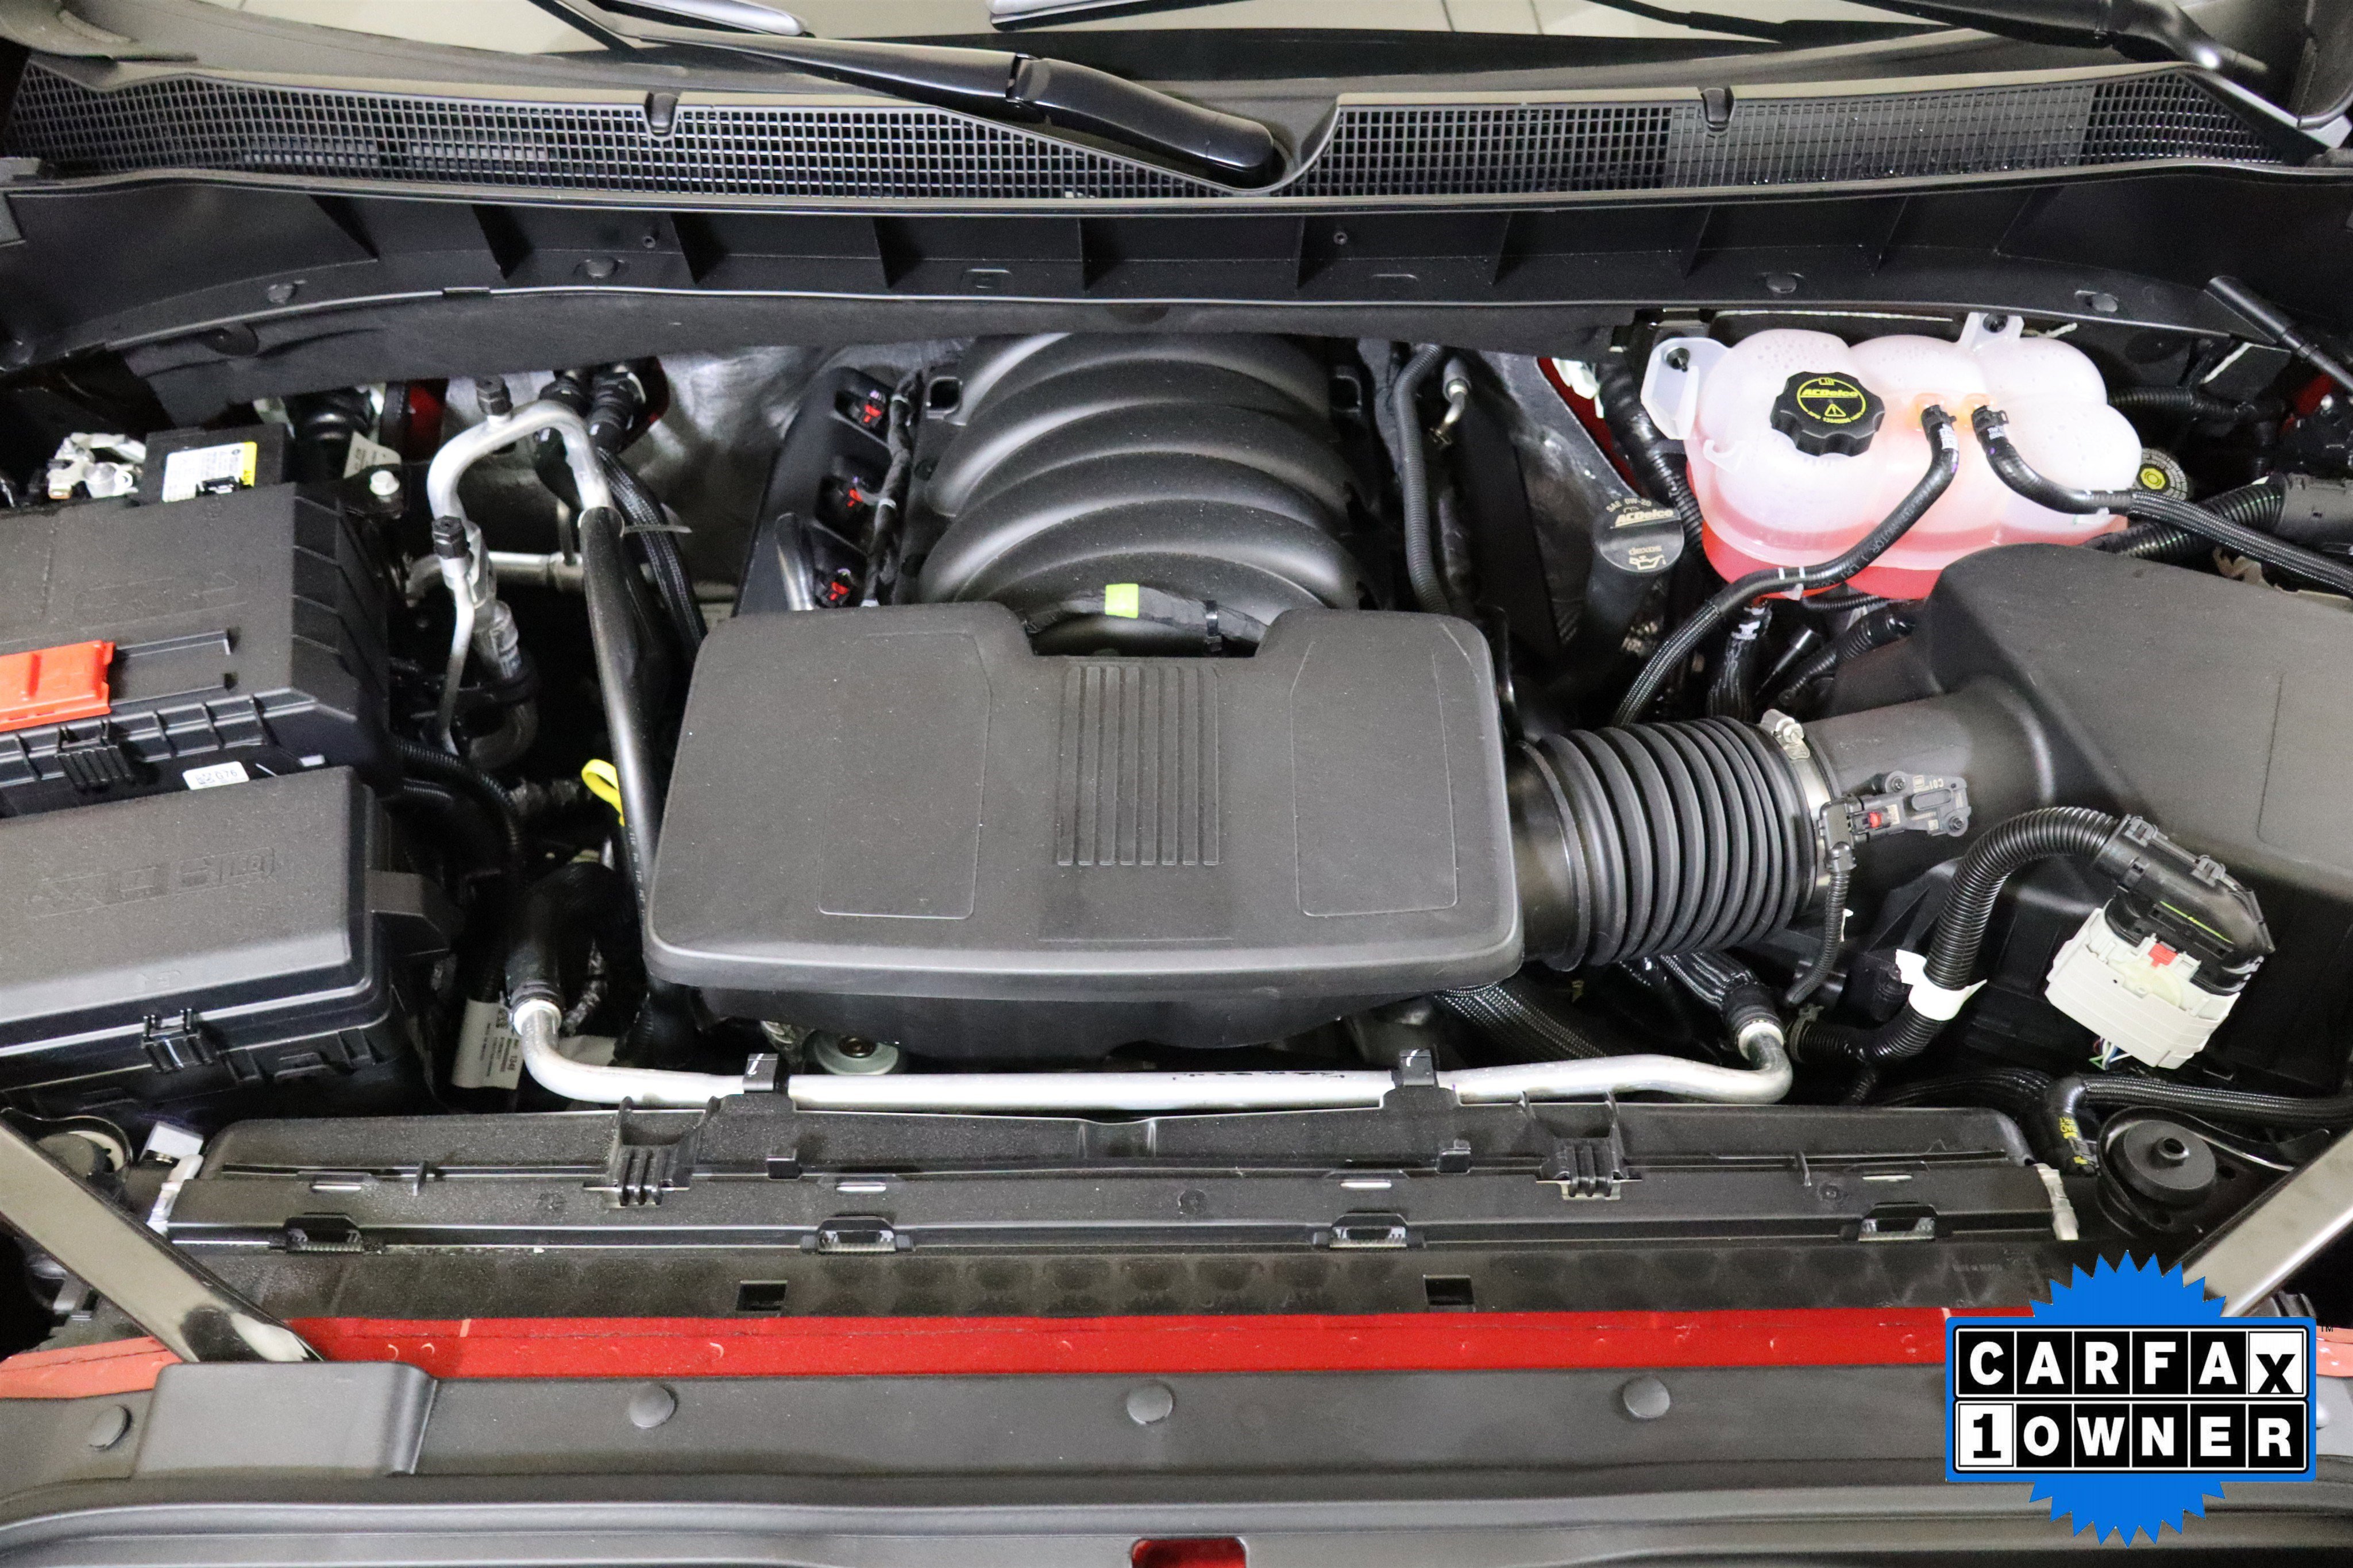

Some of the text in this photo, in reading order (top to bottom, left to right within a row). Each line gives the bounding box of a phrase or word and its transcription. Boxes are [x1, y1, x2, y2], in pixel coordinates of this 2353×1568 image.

[1802, 389, 1859, 397] ACDelco
[1606, 500, 1622, 512] SAE
[1615, 509, 1674, 525] ACDelco
[1629, 546, 1662, 555] dexos
